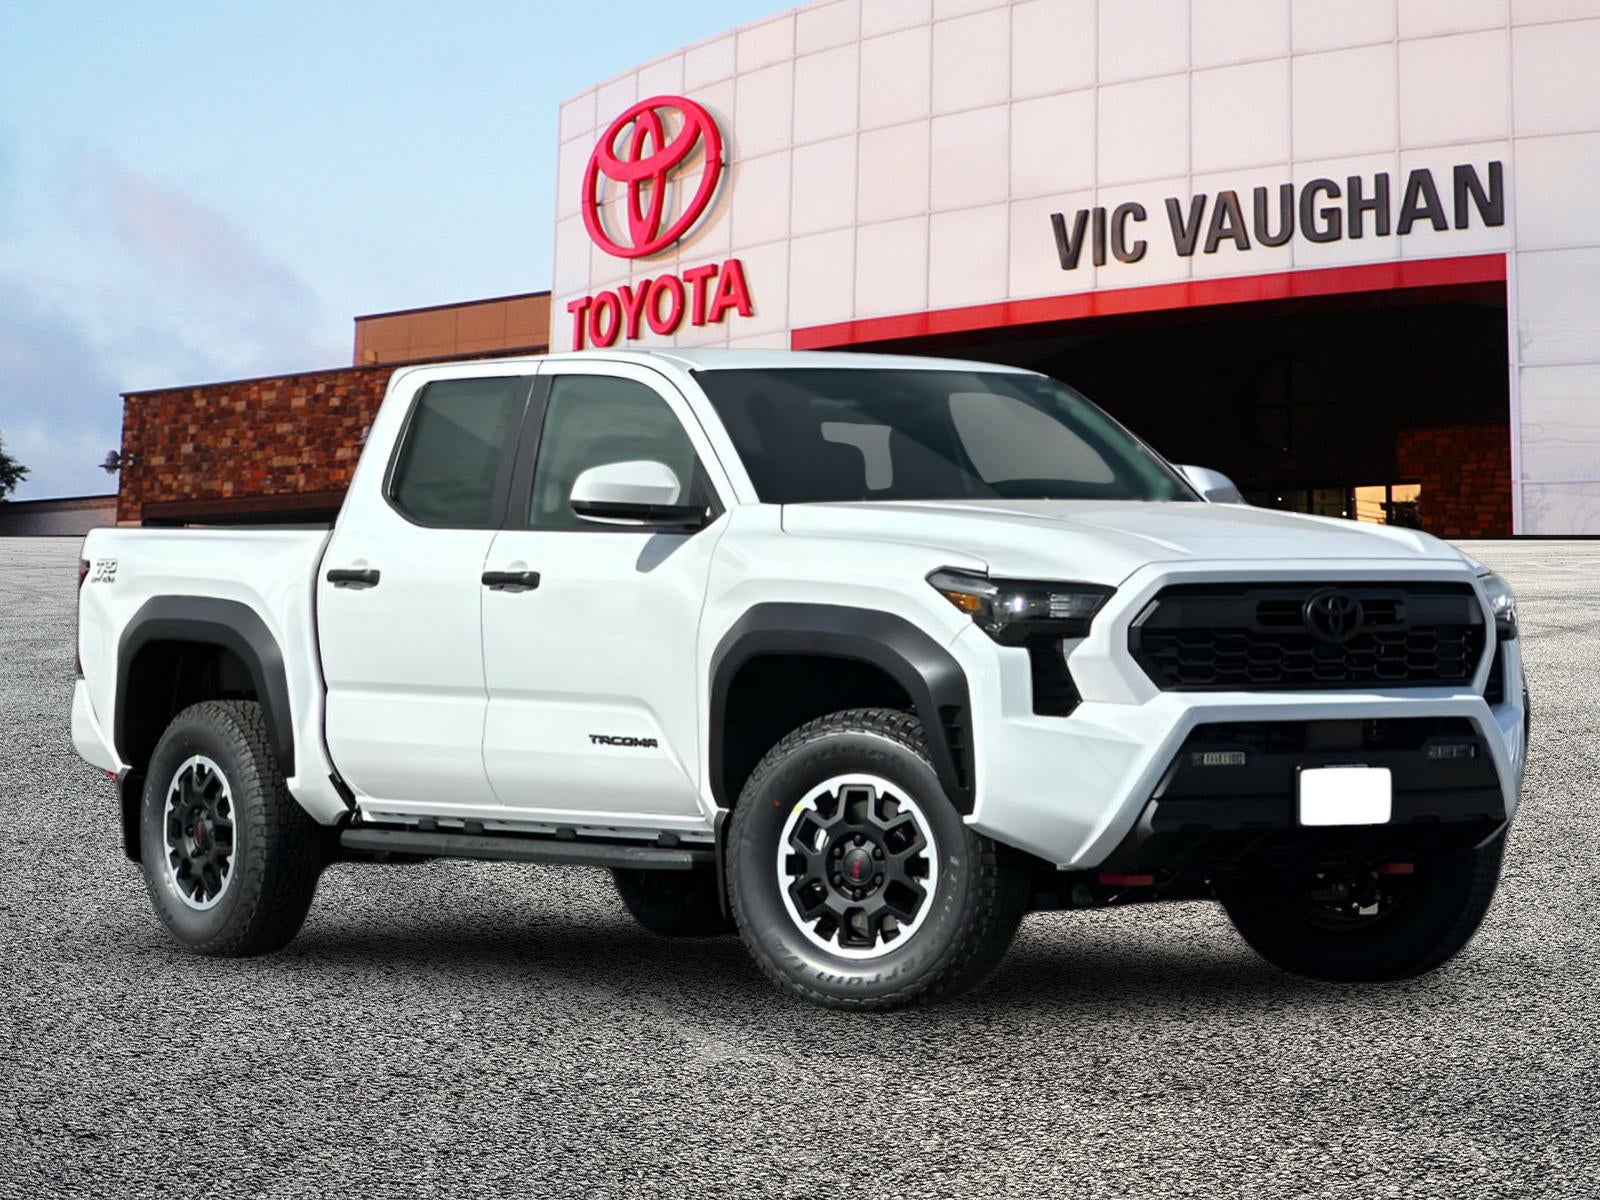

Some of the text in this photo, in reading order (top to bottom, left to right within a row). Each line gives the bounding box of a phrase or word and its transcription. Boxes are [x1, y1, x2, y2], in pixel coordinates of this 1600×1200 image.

[1050, 161, 1505, 270] VIC VAUGHAN
[567, 258, 753, 351] TOYOTA
[588, 733, 658, 749] TACOMA
